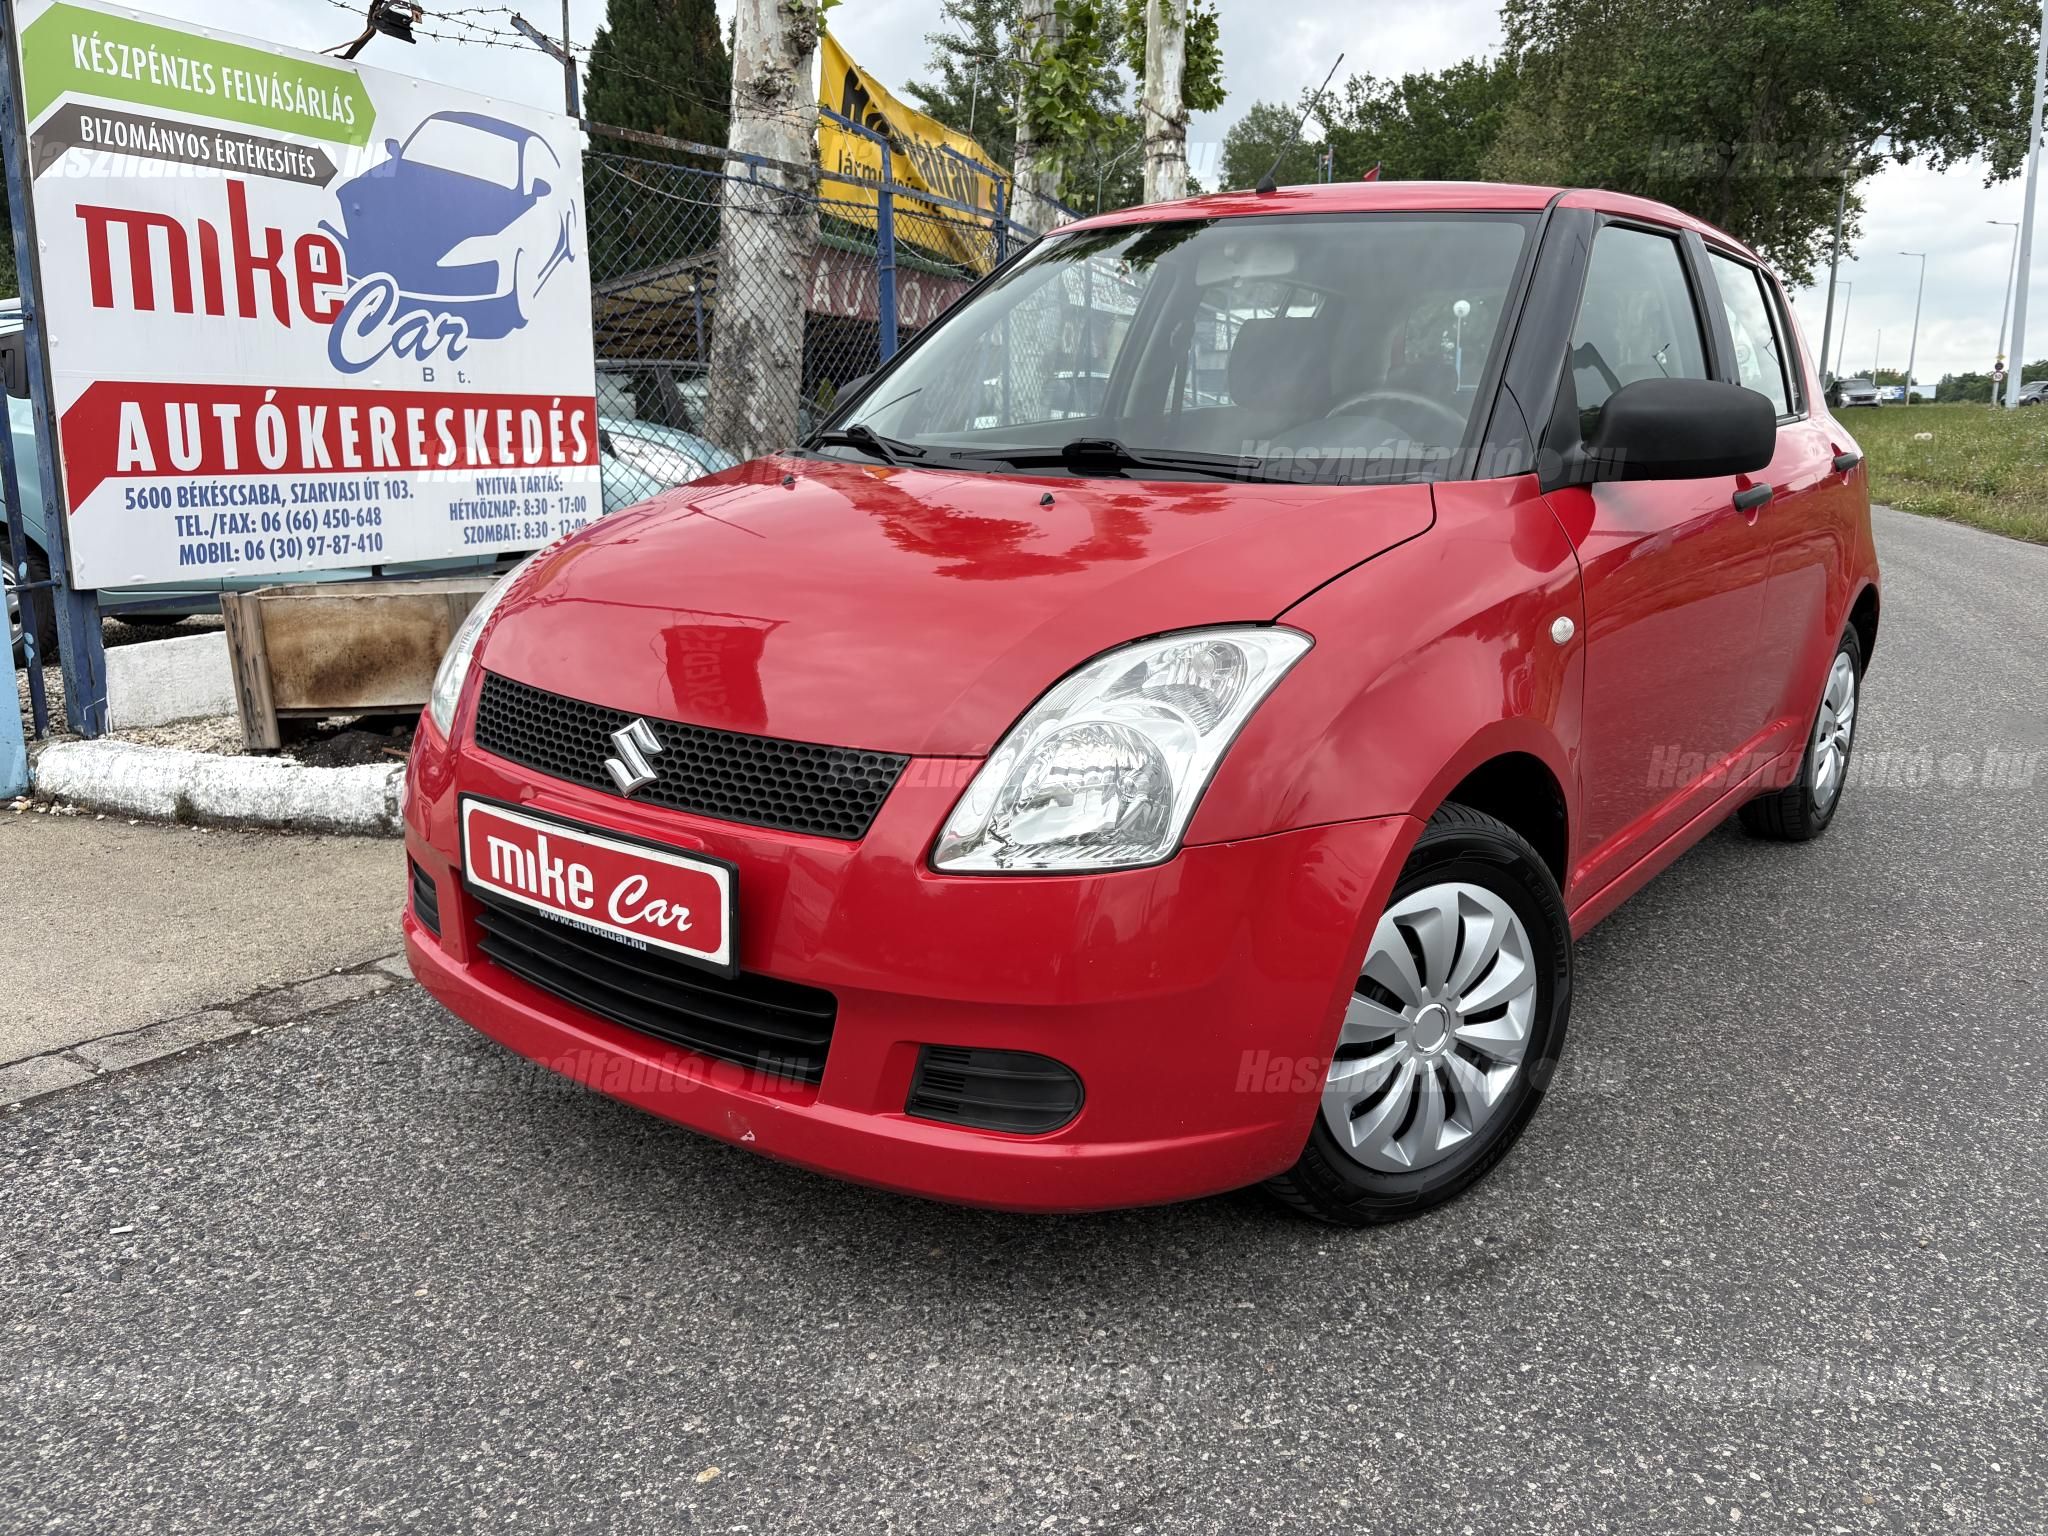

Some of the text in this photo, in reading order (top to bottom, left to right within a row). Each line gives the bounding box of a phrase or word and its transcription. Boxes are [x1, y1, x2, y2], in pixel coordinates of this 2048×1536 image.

[72, 31, 356, 125] KÉSZPÉNZES FELVÁSÁRLÁS
[80, 115, 316, 179] BIZOMÁNYOS ÉRTÉKESÍTÉS
[75, 179, 470, 374] mike Car
[116, 389, 588, 472] AUTÓKERESKEDÉS
[125, 476, 414, 511] 5600 BÉKÉSCSABA, SZARVASI ÚT 103.
[476, 472, 563, 496] NYITVA TARTÁS:
[175, 506, 382, 539] TEL./FAX: 06 (66) 450-648
[450, 498, 521, 521] HÉTKÖZNAP:
[524, 498, 548, 516] 8:30
[558, 496, 586, 514] 17:00
[179, 532, 383, 566] MOBIL: 06 (30) 97-87-410
[464, 523, 521, 545] SZOMBAT:
[524, 520, 548, 539] 8:30
[487, 830, 693, 932] mike Car
